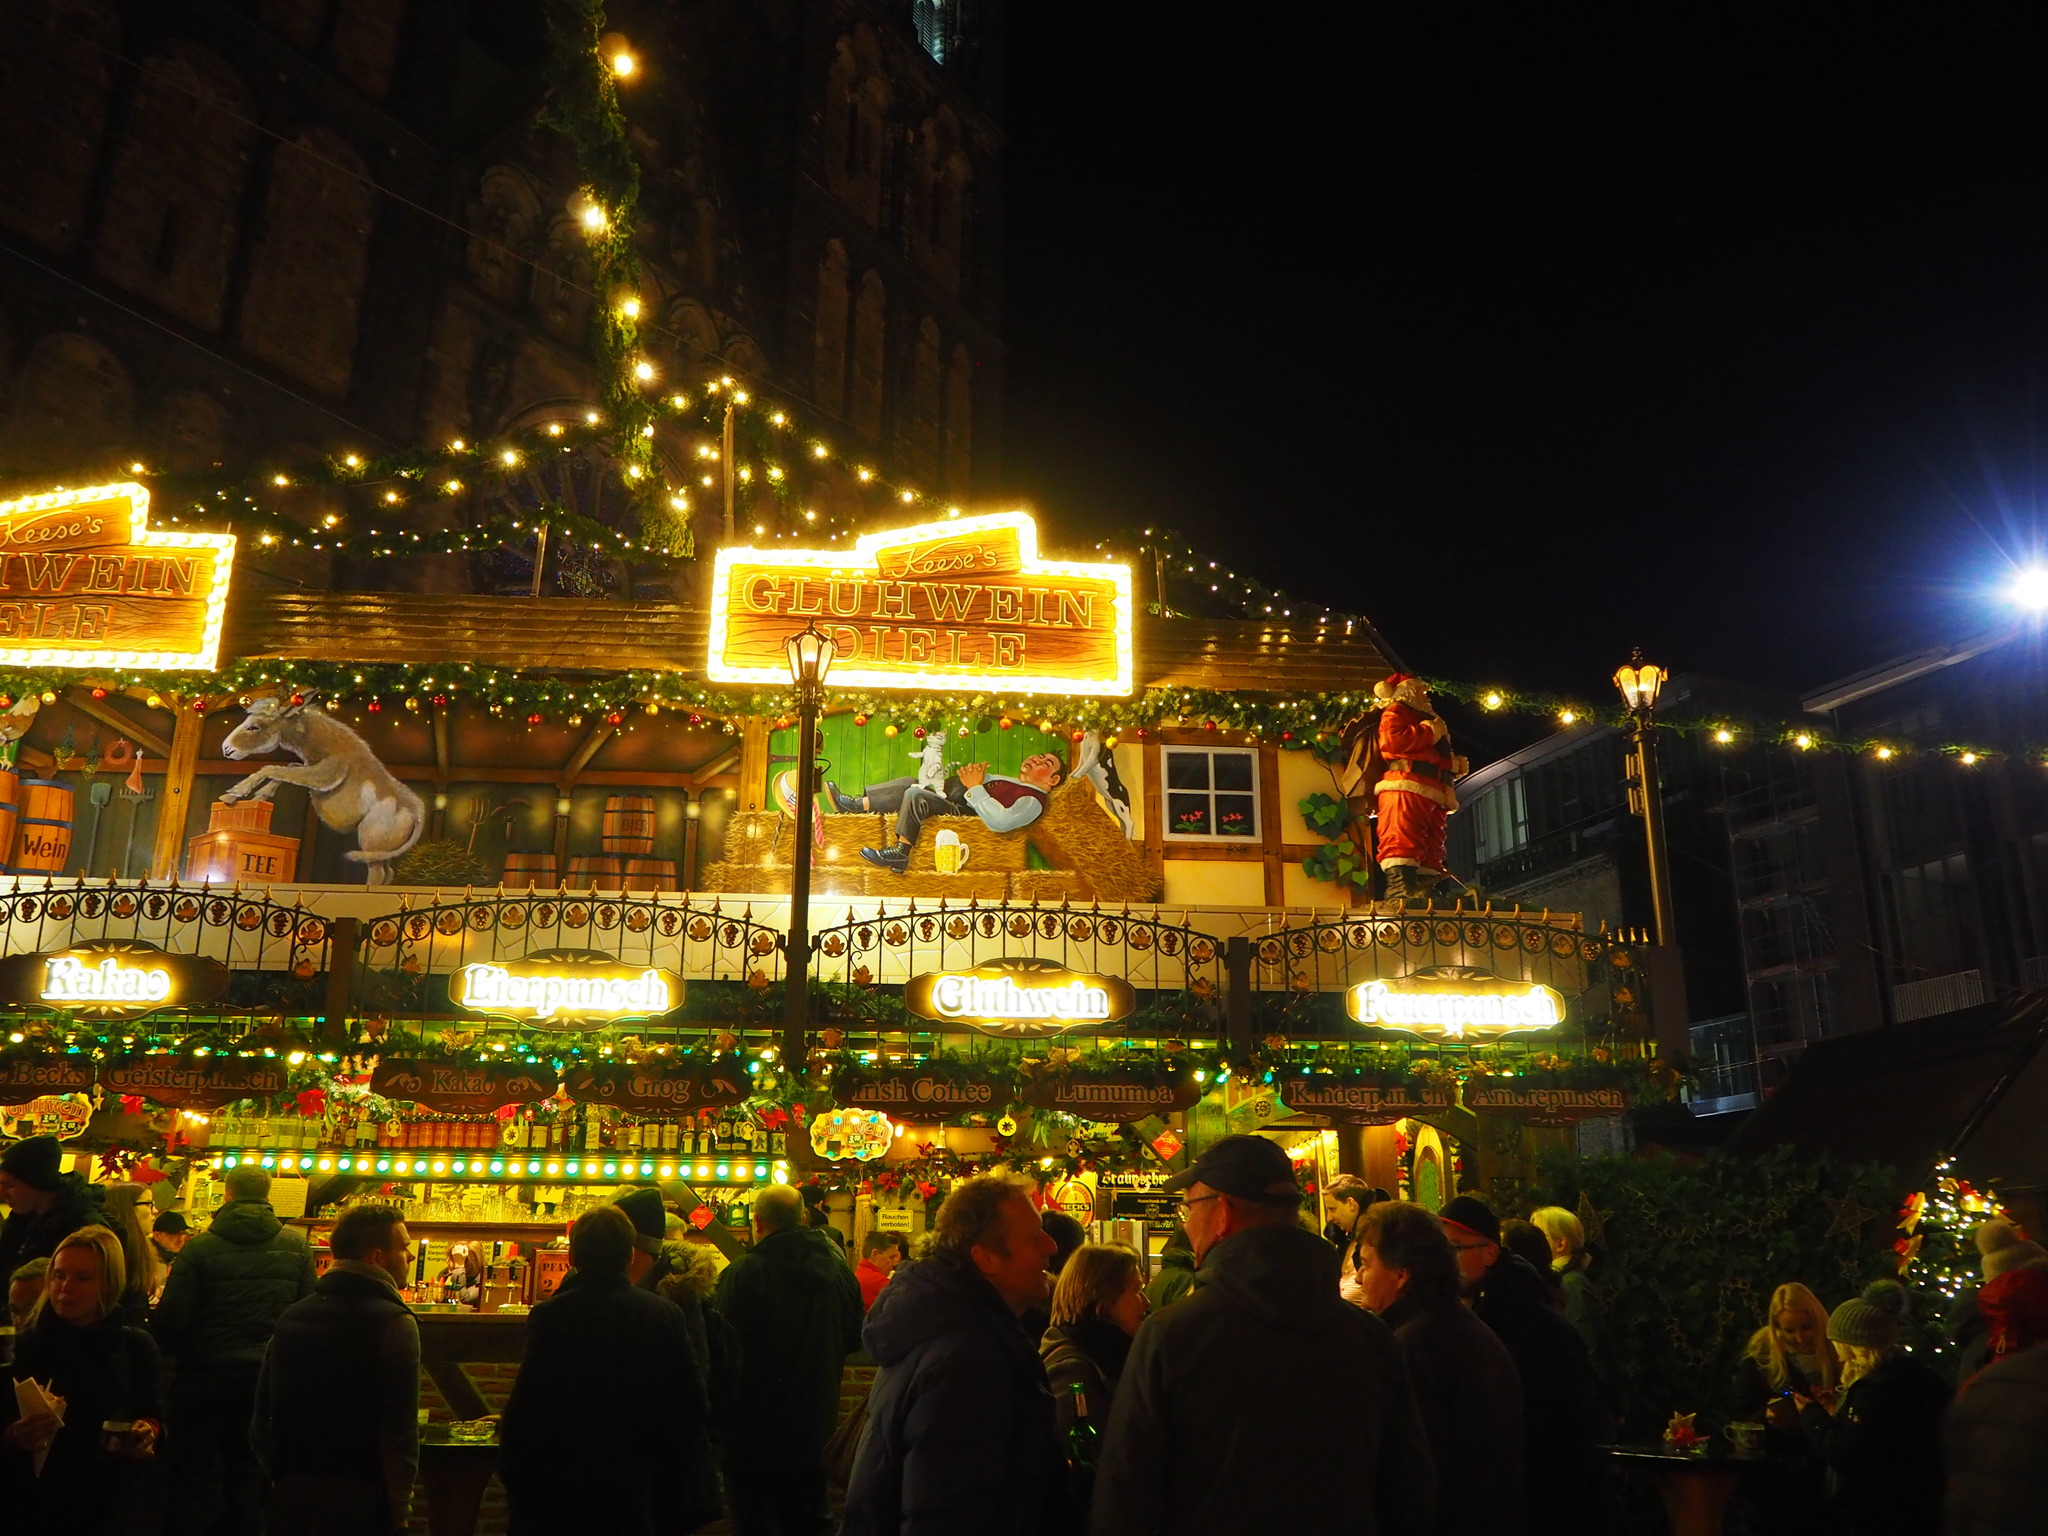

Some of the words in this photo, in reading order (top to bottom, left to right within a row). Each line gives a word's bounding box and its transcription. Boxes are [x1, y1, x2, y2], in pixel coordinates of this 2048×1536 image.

[0, 508, 104, 548] Keese's
[891, 540, 998, 578] Keese's
[742, 568, 1098, 629] GLÜHWEIN
[822, 622, 1027, 671] DIELE
[23, 833, 66, 859] Wein
[241, 853, 277, 875] TEE
[40, 956, 171, 1002] Kakao
[462, 963, 669, 1016] Eierpunsch
[932, 975, 1110, 1019] Glühwein
[1356, 980, 1559, 1034] Feuerpunsch
[10, 1061, 86, 1086] Becks
[431, 1069, 495, 1095] Kakao
[628, 1074, 690, 1104] Grog
[852, 1077, 908, 1102] Irish
